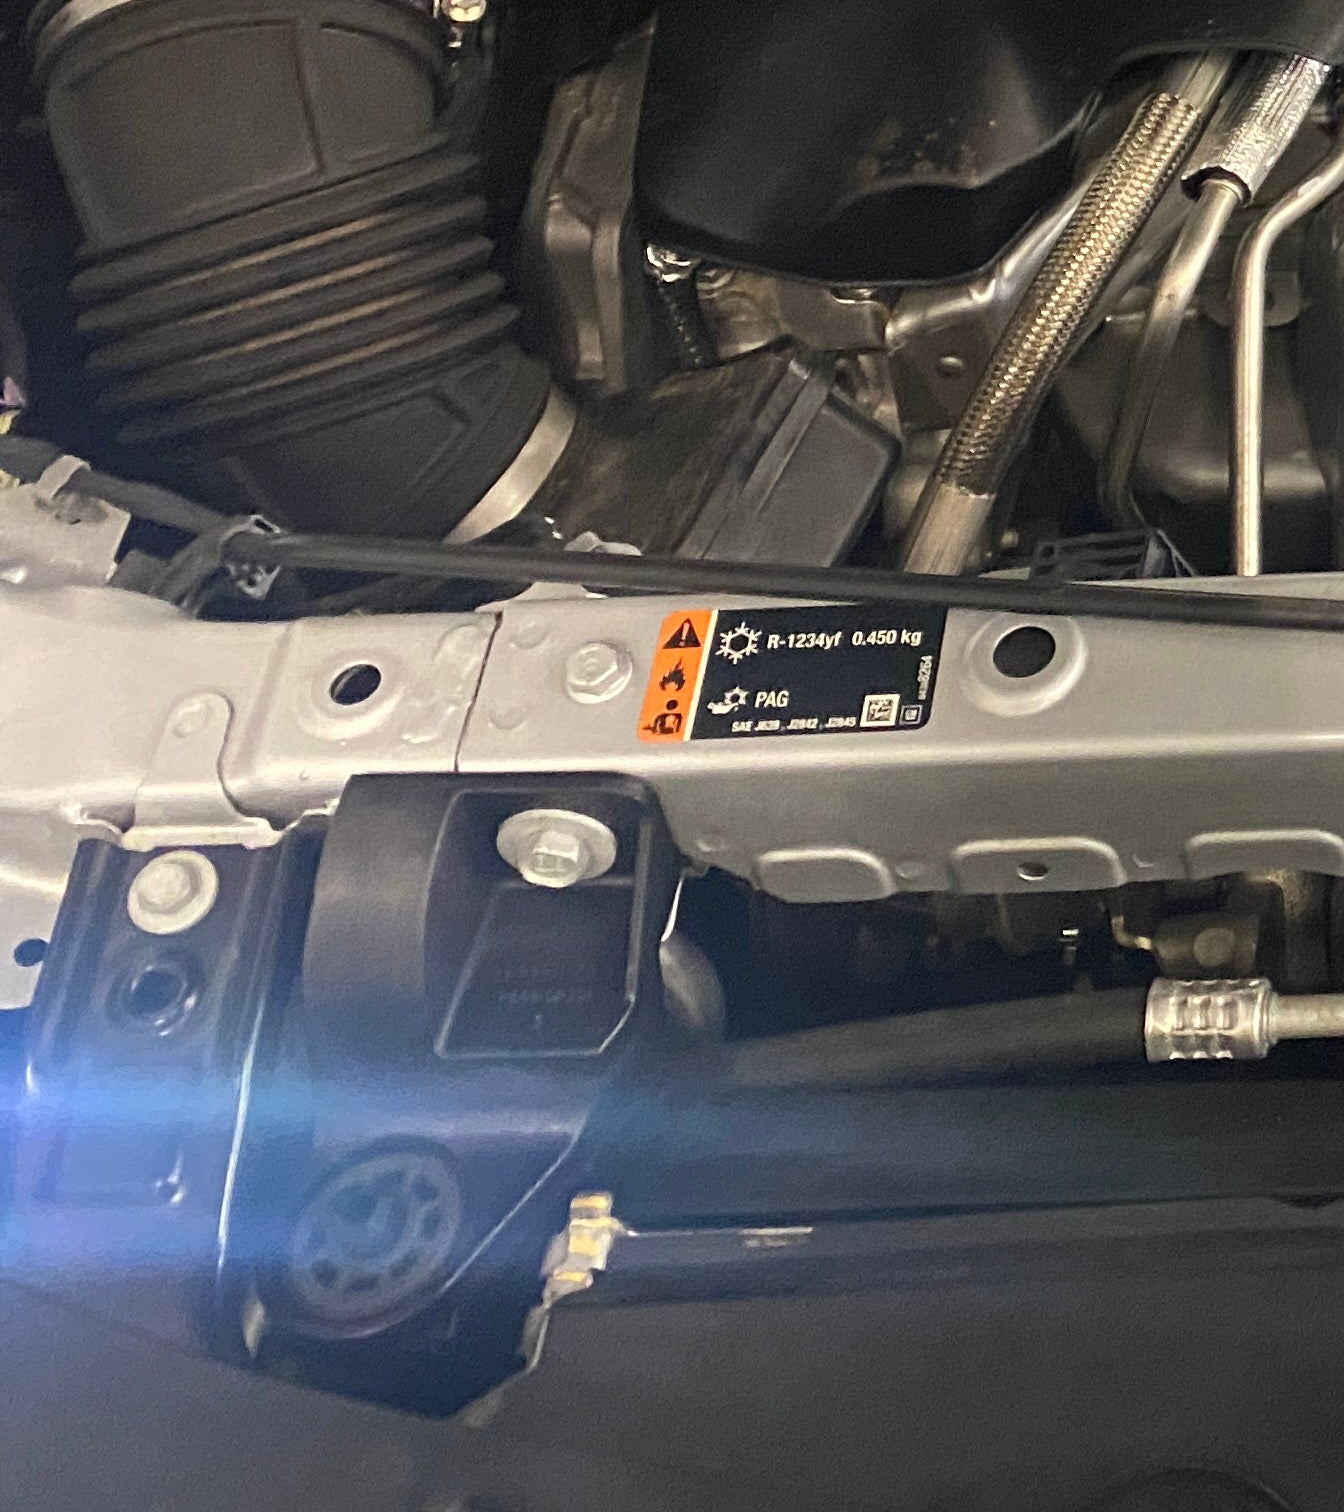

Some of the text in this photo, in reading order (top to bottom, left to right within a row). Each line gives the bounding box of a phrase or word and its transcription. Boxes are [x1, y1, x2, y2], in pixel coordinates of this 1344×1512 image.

[766, 628, 923, 650] R-1234yf 0.450 kg
[754, 690, 790, 708] PAG
[731, 720, 753, 732] SAE
